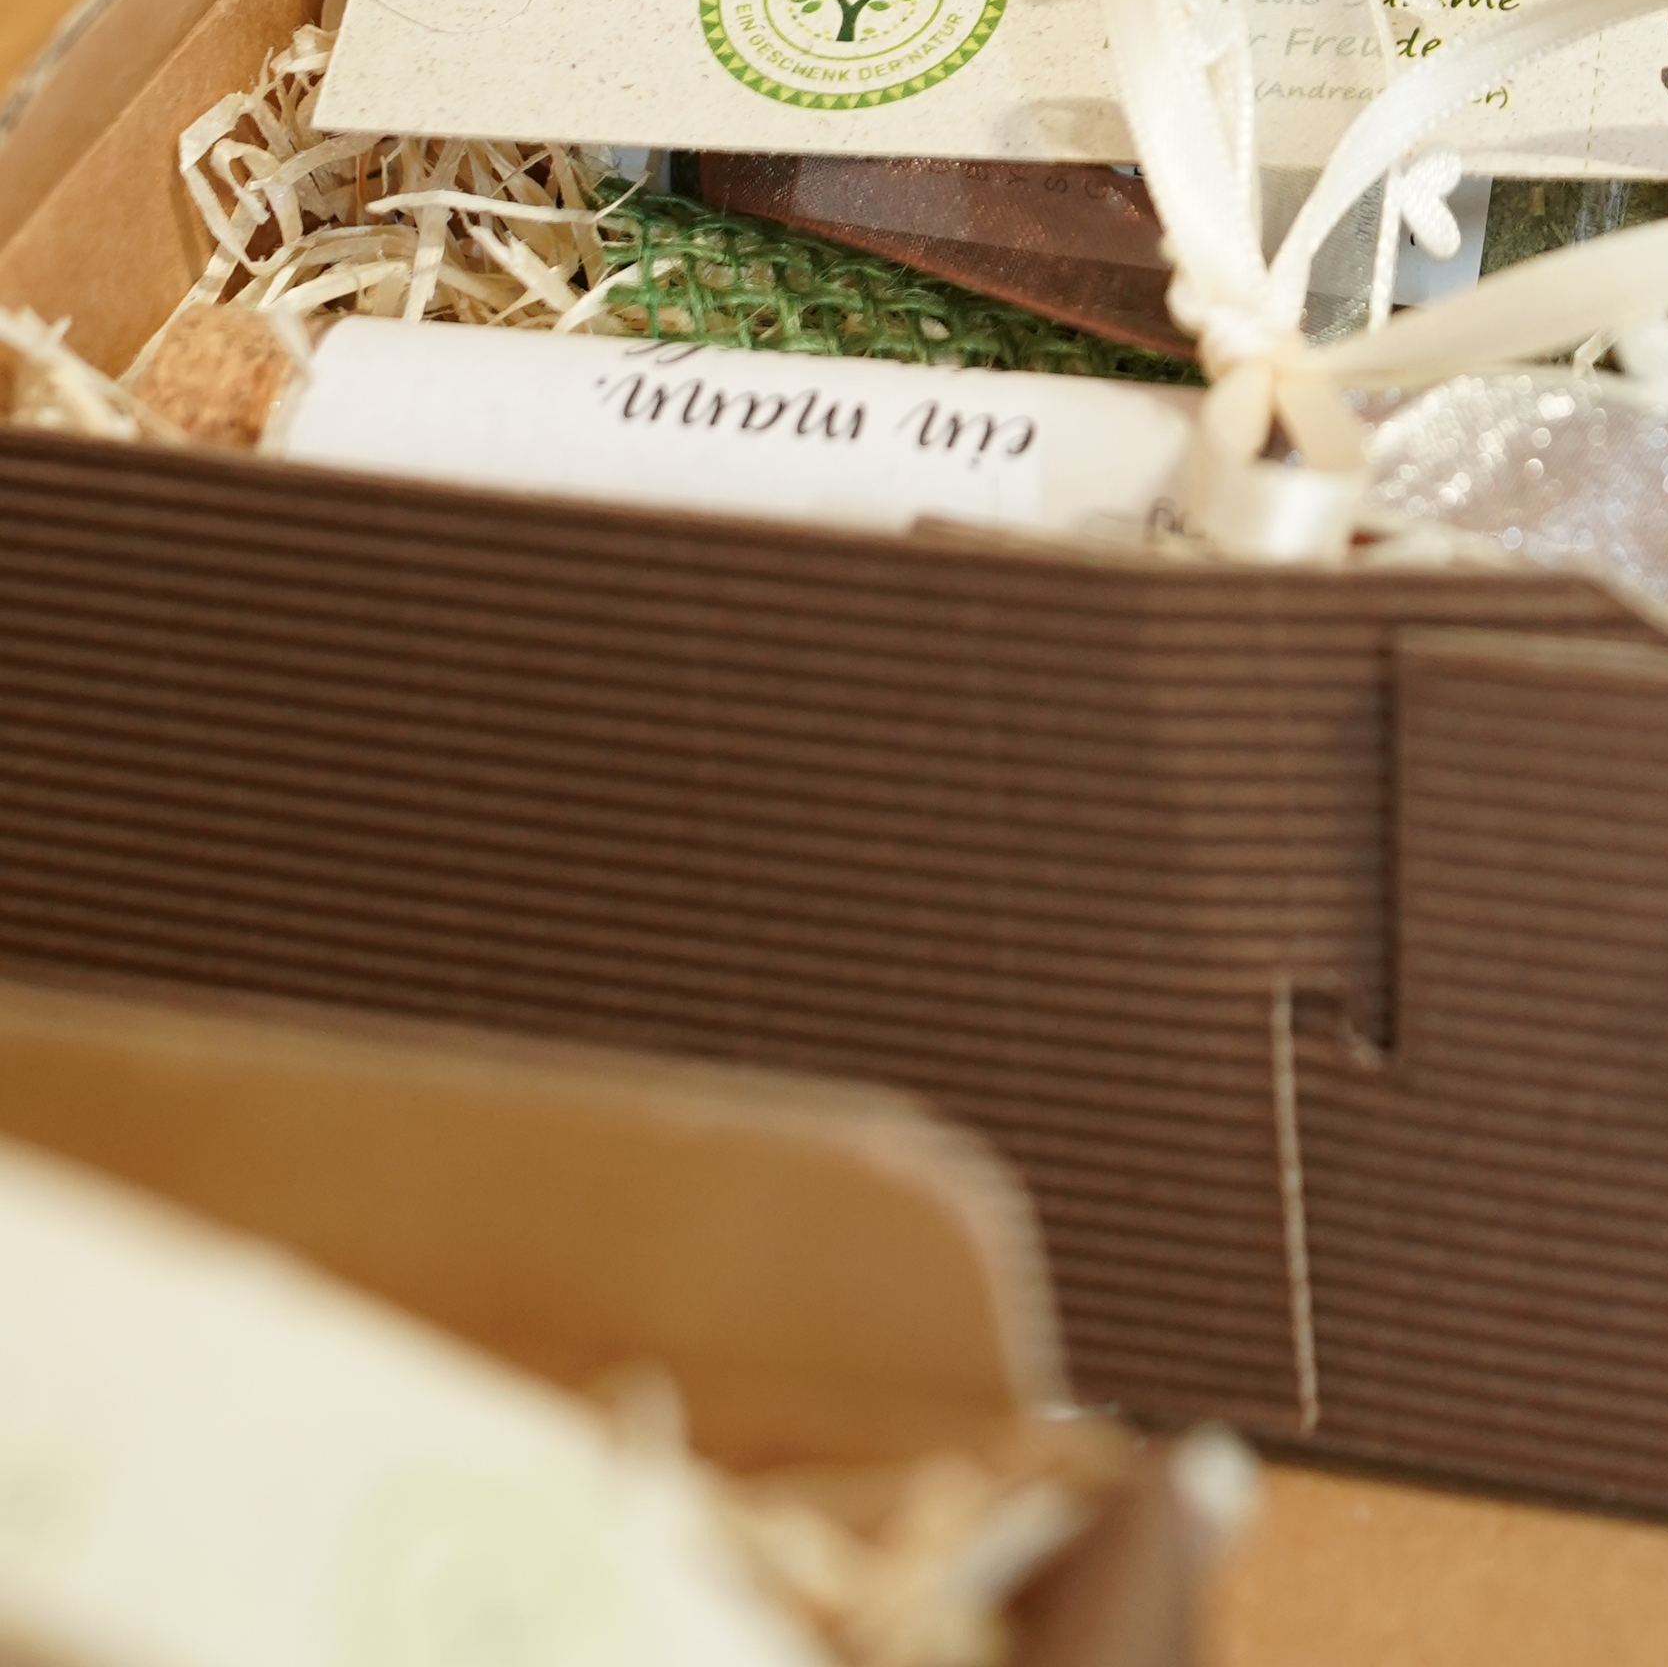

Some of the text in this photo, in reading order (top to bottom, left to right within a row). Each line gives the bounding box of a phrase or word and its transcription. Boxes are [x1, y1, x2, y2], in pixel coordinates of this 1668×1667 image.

[735, 2, 965, 82] EIN GESCHENK DER NATUR
[898, 398, 1037, 470] ein
